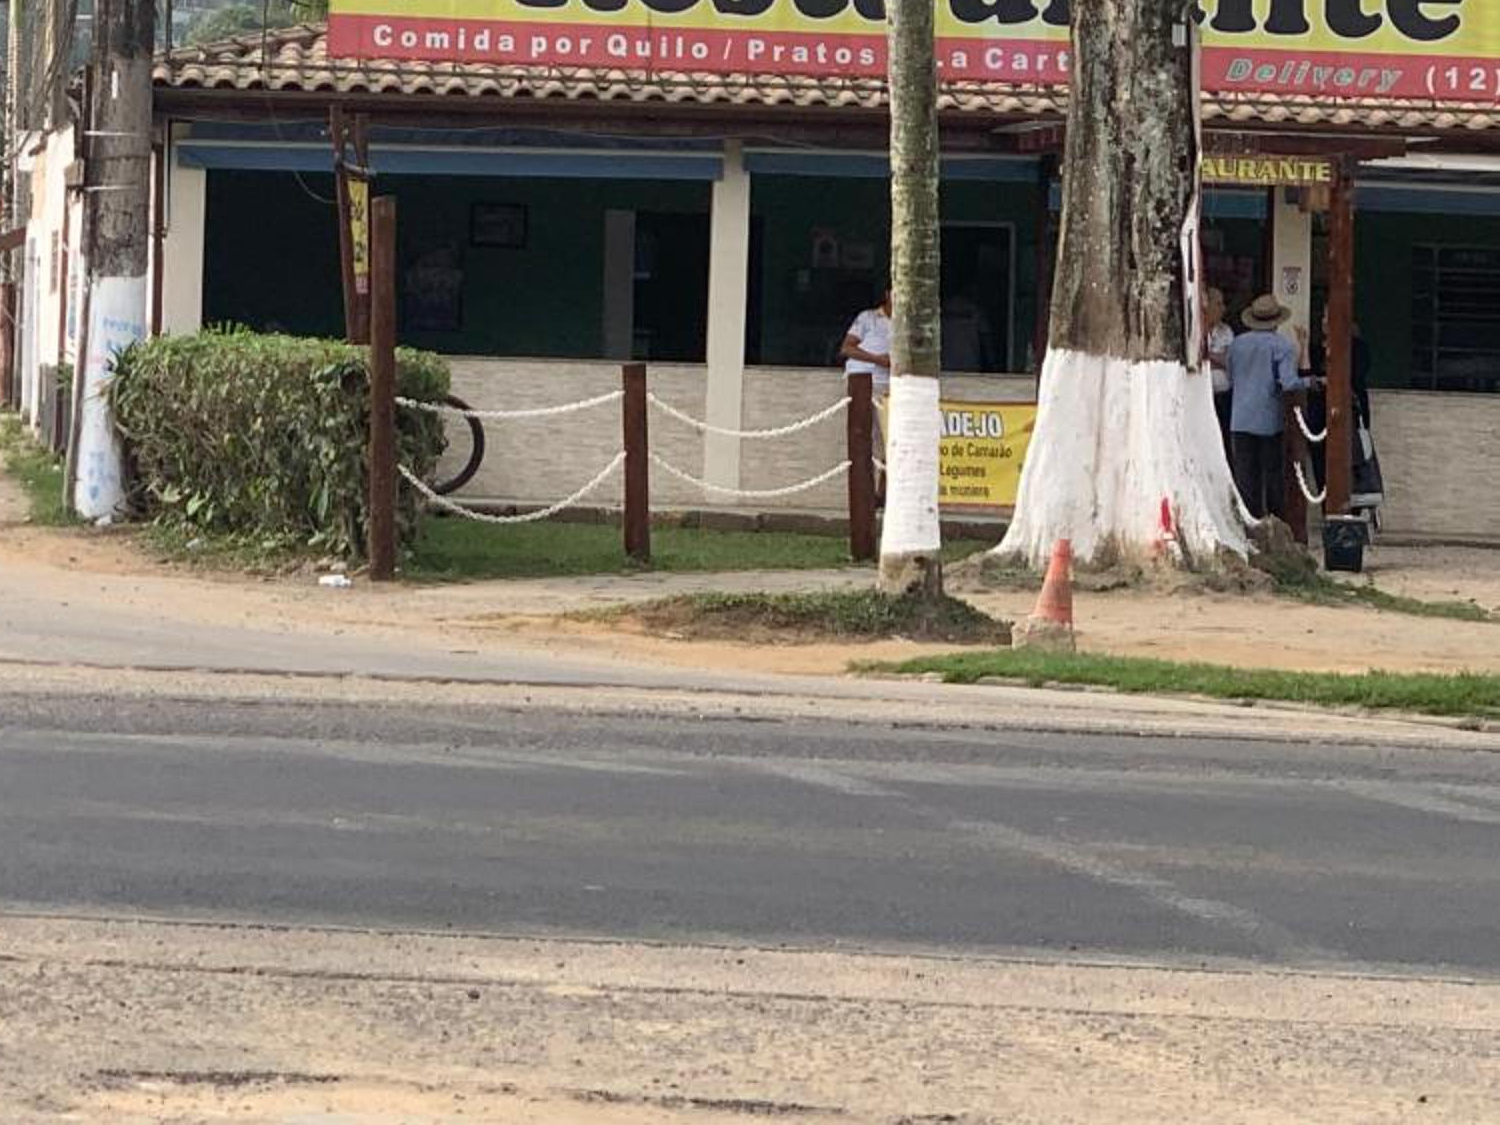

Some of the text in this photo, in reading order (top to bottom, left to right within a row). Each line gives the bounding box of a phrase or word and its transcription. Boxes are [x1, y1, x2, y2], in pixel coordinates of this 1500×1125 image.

[373, 25, 515, 52] Comida
[531, 34, 591, 57] por
[607, 33, 709, 59] Quilo
[747, 39, 876, 65] Pratos
[984, 47, 1069, 72] Cart
[1225, 58, 1403, 92] Delivery
[1201, 157, 1332, 182] AURANTE
